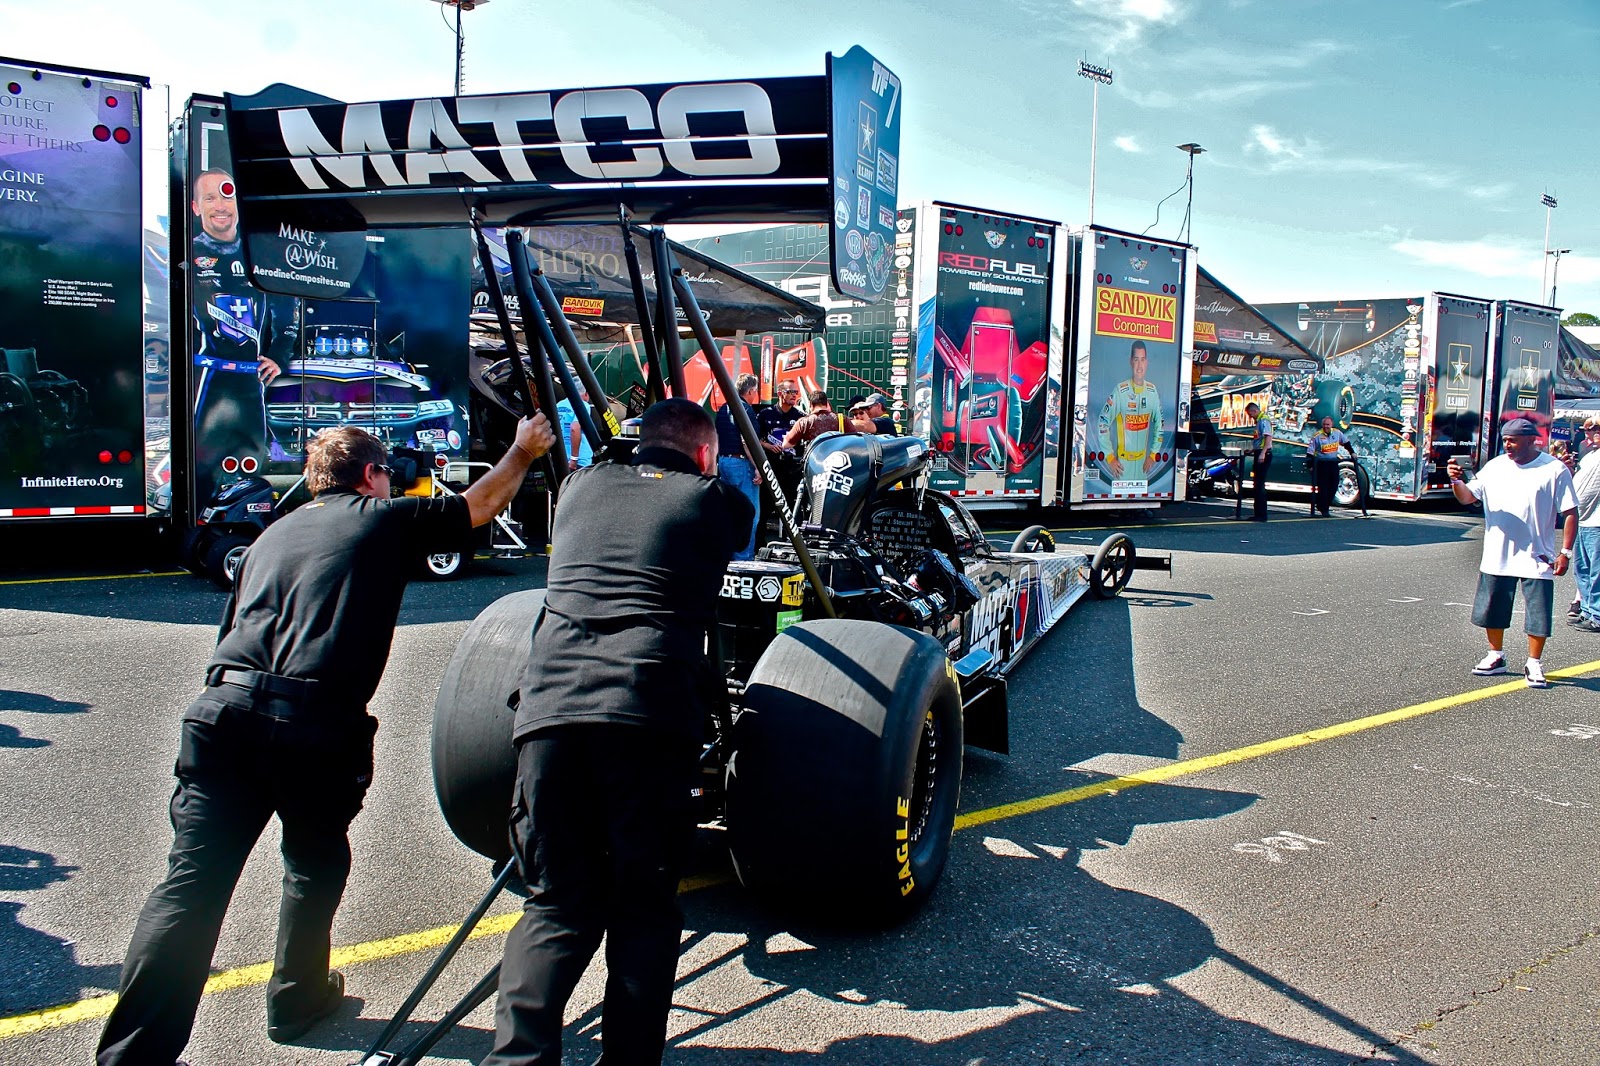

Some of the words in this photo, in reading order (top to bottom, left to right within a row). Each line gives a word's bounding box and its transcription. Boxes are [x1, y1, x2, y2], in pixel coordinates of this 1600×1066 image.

[885, 73, 901, 129] 7
[24, 133, 87, 153] THEIRS.
[277, 81, 781, 189] MATCO
[0, 169, 45, 185] GINE
[537, 231, 619, 252] INFINITE
[539, 249, 620, 278] HERO
[253, 264, 351, 289] AerodineComposites.com
[839, 268, 867, 288] TRAXXAS
[939, 266, 981, 277] POWERED
[993, 274, 1044, 285] SCHUMACHER
[968, 281, 1024, 296] redfuelpower.com
[564, 298, 603, 309] SANDVIK
[1099, 289, 1174, 320] SANDVIK
[1113, 317, 1160, 335] Coromant
[1218, 392, 1272, 430] ARMY
[21, 474, 123, 488] InfiniteHero.Org
[811, 470, 854, 488] MATCO
[811, 479, 852, 496] TOOLS
[762, 459, 799, 537] GOODYEAR
[723, 574, 754, 589] TCO
[721, 585, 754, 600] OLS
[896, 796, 915, 896] EAGLE
